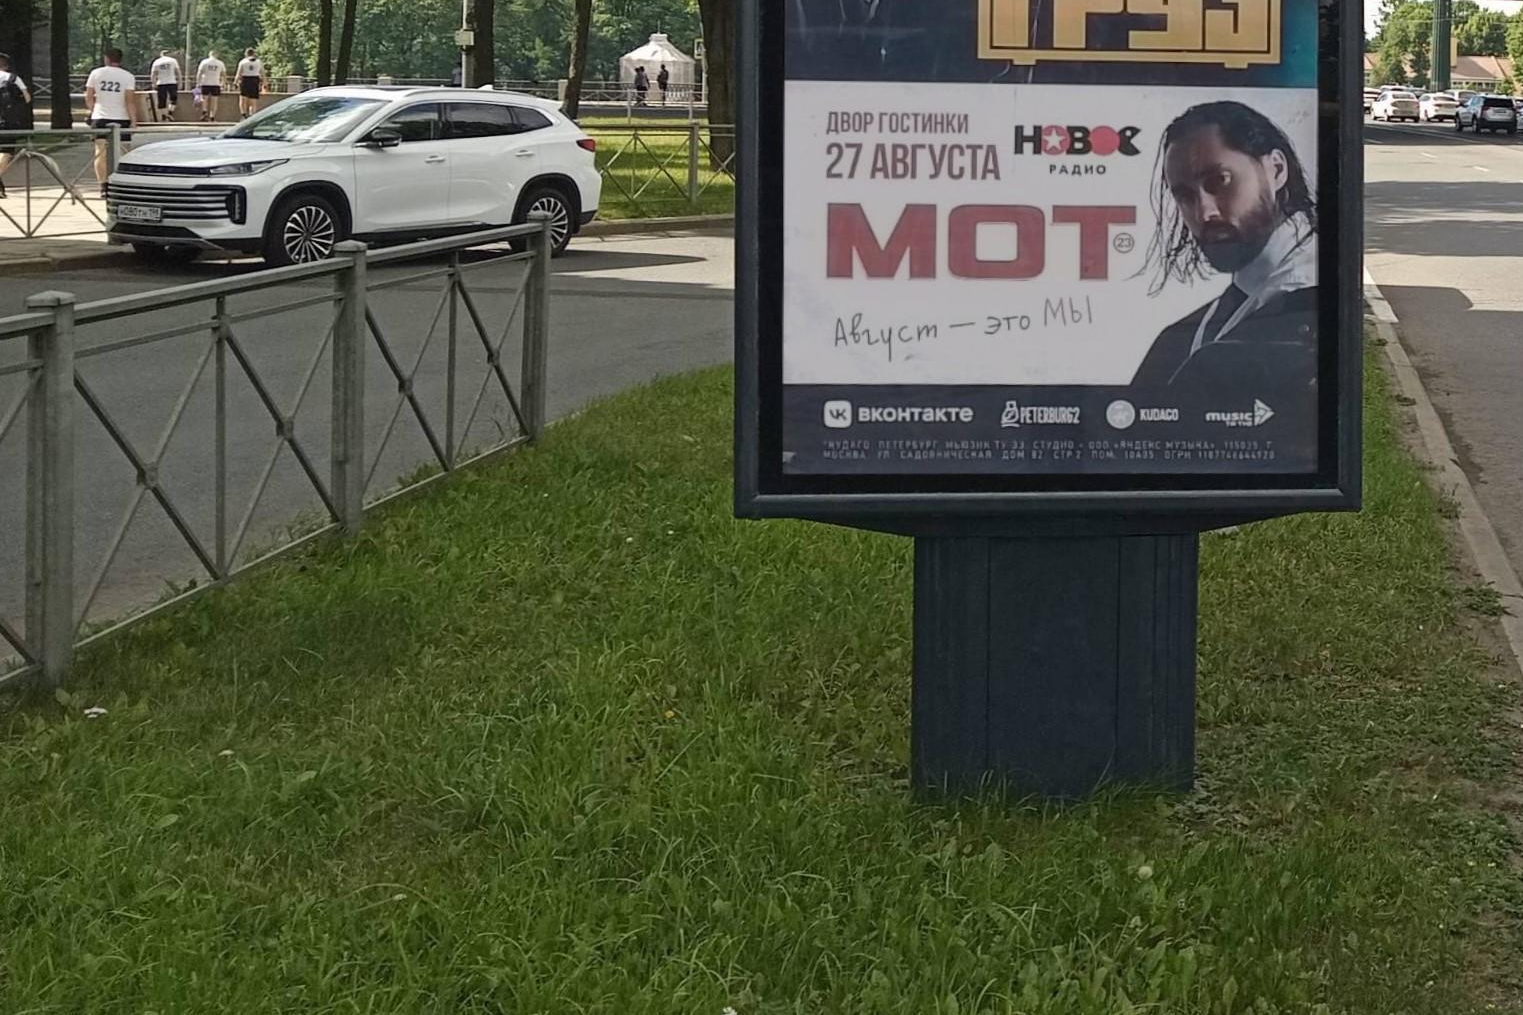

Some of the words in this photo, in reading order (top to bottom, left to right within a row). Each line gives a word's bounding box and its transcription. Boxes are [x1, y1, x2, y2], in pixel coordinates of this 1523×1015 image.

[100, 80, 121, 92] 222
[826, 111, 874, 135] ДВОР
[878, 112, 969, 135] ГОСТИНКИ
[826, 143, 863, 179] 27
[869, 143, 1001, 181] АВГУСТА
[1049, 164, 1106, 175] РАДИО
[826, 202, 1137, 281] МОТ
[834, 312, 938, 362] Август
[984, 315, 1031, 336] это
